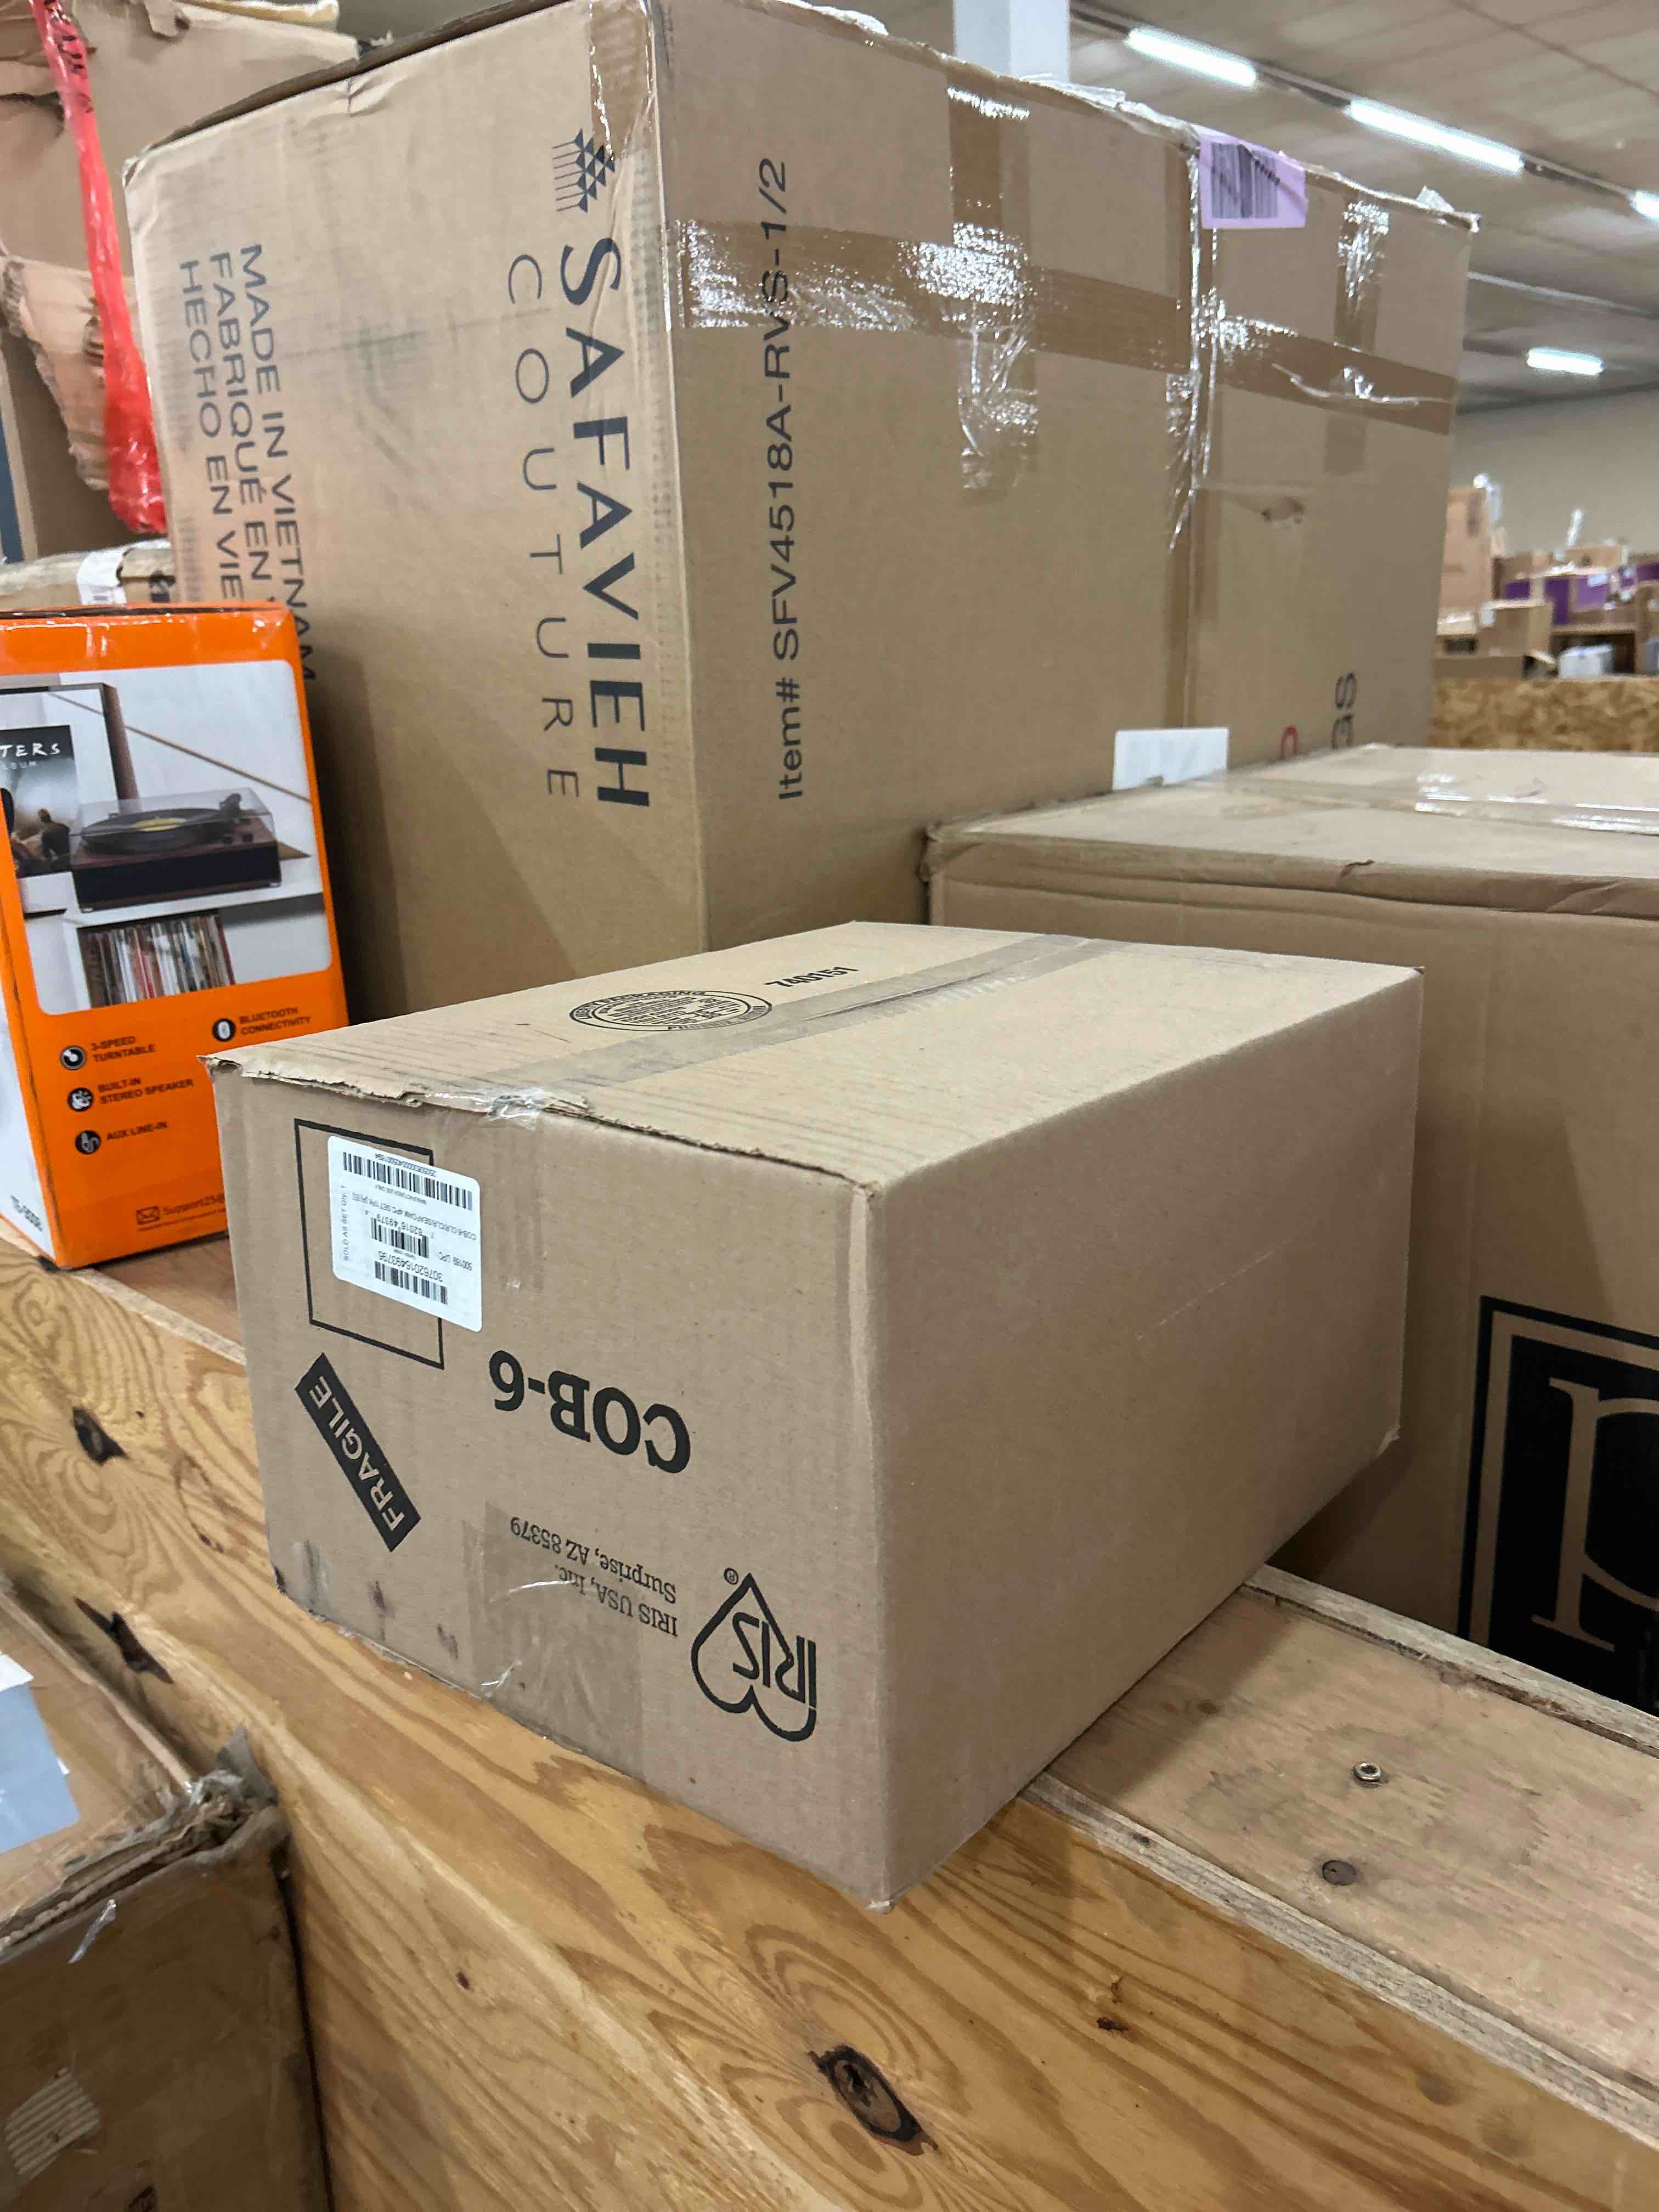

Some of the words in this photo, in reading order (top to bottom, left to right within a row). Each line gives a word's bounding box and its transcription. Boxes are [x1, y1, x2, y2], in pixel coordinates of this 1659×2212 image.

[180, 260, 222, 438] HECHO
[206, 455, 233, 515] EN
[240, 244, 280, 395] MADE
[262, 412, 289, 458] IN
[210, 252, 267, 505] FABRIQUÉ
[244, 521, 272, 580] EN
[759, 157, 799, 661] SFV4518A-RVS-1/2
[508, 254, 580, 798] COUTURE
[560, 237, 650, 807] SAFAVIEH
[778, 676, 803, 801] Item#
[764, 967, 860, 987] 740151
[93, 1043, 156, 1062] TURNTABLE
[100, 1089, 143, 1104] STEREO
[145, 1079, 194, 1094] SPEAKER
[309, 1375, 405, 1531] FRAGILE
[489, 1350, 691, 1474] COB-6
[510, 1516, 562, 1554] 85379
[555, 1564, 587, 1596] Inc.
[566, 1539, 590, 1566] AZ
[595, 1548, 676, 1604] Surprise,
[591, 1577, 634, 1618] USA,
[638, 1603, 678, 1637] IRIS
[732, 1612, 817, 1709] IRIS
